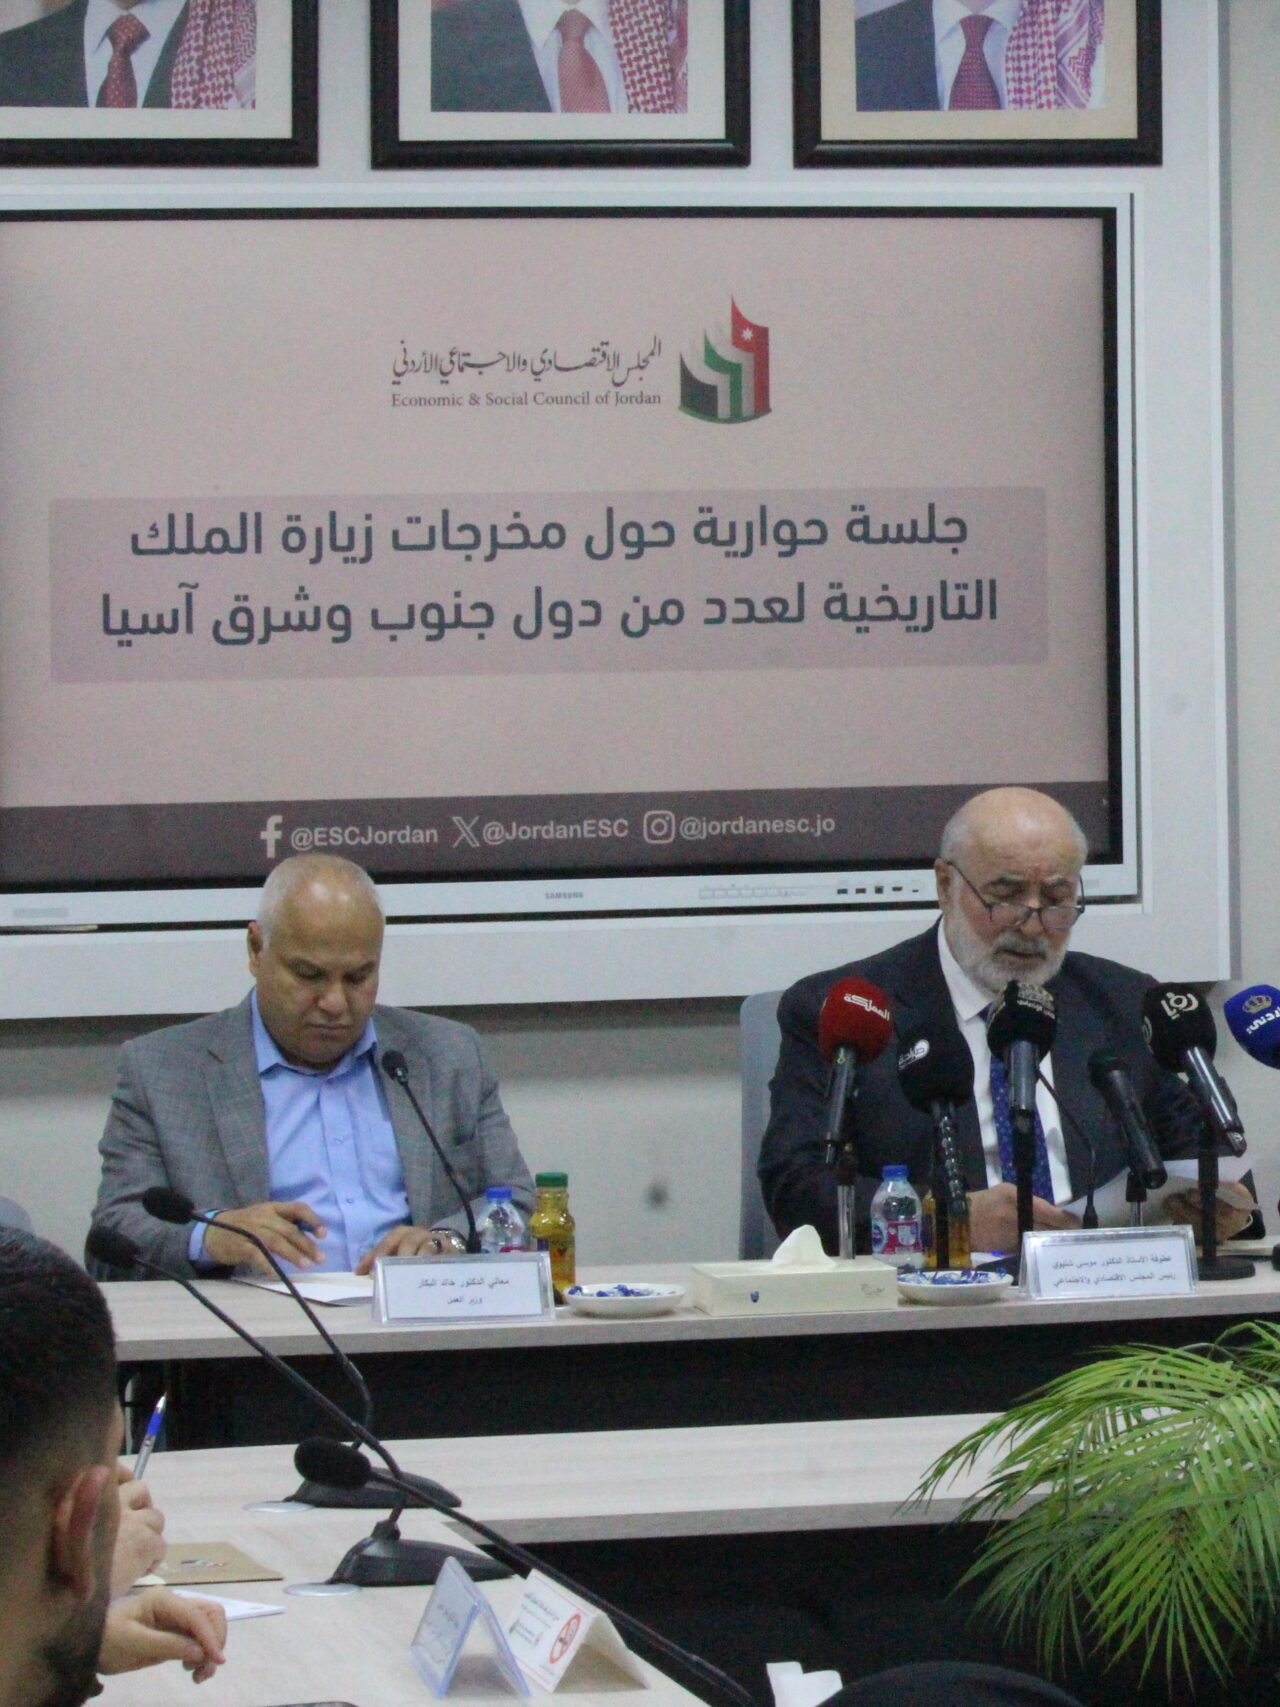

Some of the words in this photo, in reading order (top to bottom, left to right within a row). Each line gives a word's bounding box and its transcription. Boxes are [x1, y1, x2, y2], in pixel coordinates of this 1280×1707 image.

[611, 334, 662, 388] المجلس
[391, 392, 464, 407] Economic
[467, 392, 481, 406] &
[485, 391, 528, 406] Social
[533, 390, 590, 406] Council
[594, 390, 611, 405] of
[614, 390, 662, 407] Jordan
[130, 511, 263, 556] الملك
[280, 509, 374, 565] زيارة
[391, 508, 567, 563] مخرجات
[584, 506, 676, 561] حول
[692, 504, 829, 559] حوارية
[845, 502, 968, 555] جلسة
[101, 581, 200, 648] آسيا
[211, 585, 352, 647] وشرق
[370, 590, 495, 642] جنوب
[512, 584, 603, 641] دول
[619, 595, 686, 639] من
[702, 581, 806, 626] لعدد
[822, 578, 998, 634] التاريخية
[290, 825, 439, 851] @ESCJordan
[482, 818, 630, 846] @JordanESC
[679, 813, 837, 841] @jordanesc.jo
[545, 892, 584, 900] SAMSUNG
